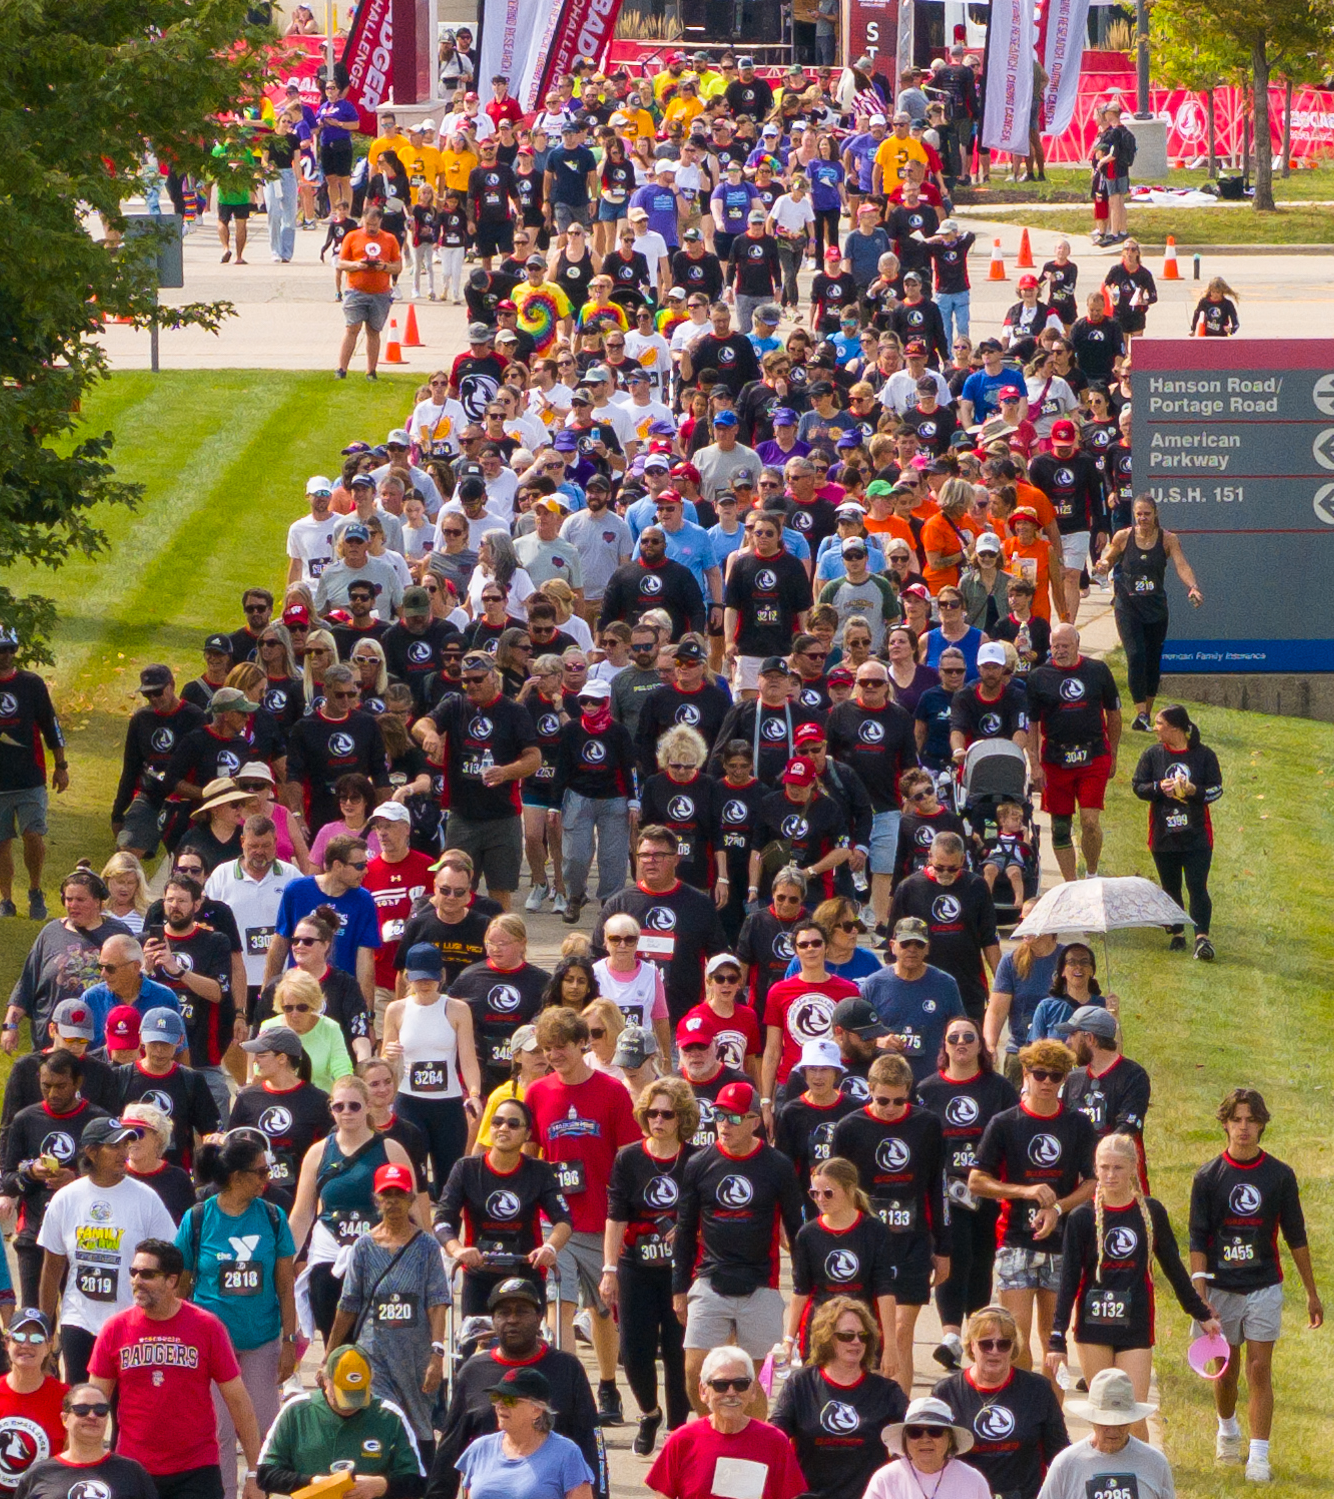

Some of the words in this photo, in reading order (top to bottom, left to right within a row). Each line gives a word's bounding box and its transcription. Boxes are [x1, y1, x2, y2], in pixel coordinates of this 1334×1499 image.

[1149, 377, 1221, 393] Hanson
[1227, 377, 1283, 394] Road/
[1149, 397, 1224, 414] Portage
[1230, 397, 1278, 413] Road
[1151, 431, 1240, 448] American
[1149, 452, 1229, 470] Parkway
[1149, 487, 1206, 503] U.S.H.
[1213, 487, 1244, 502] 151
[1195, 652, 1223, 662] Family
[1225, 652, 1266, 662] Insurance
[414, 1071, 443, 1085] 3264
[814, 1144, 830, 1159] 28
[953, 1152, 977, 1167] 292
[216, 1252, 232, 1261] the
[1224, 1244, 1254, 1261] 3455
[378, 1303, 412, 1320] 2820
[1091, 1301, 1125, 1318] 3132
[120, 1343, 198, 1370] BADGERS
